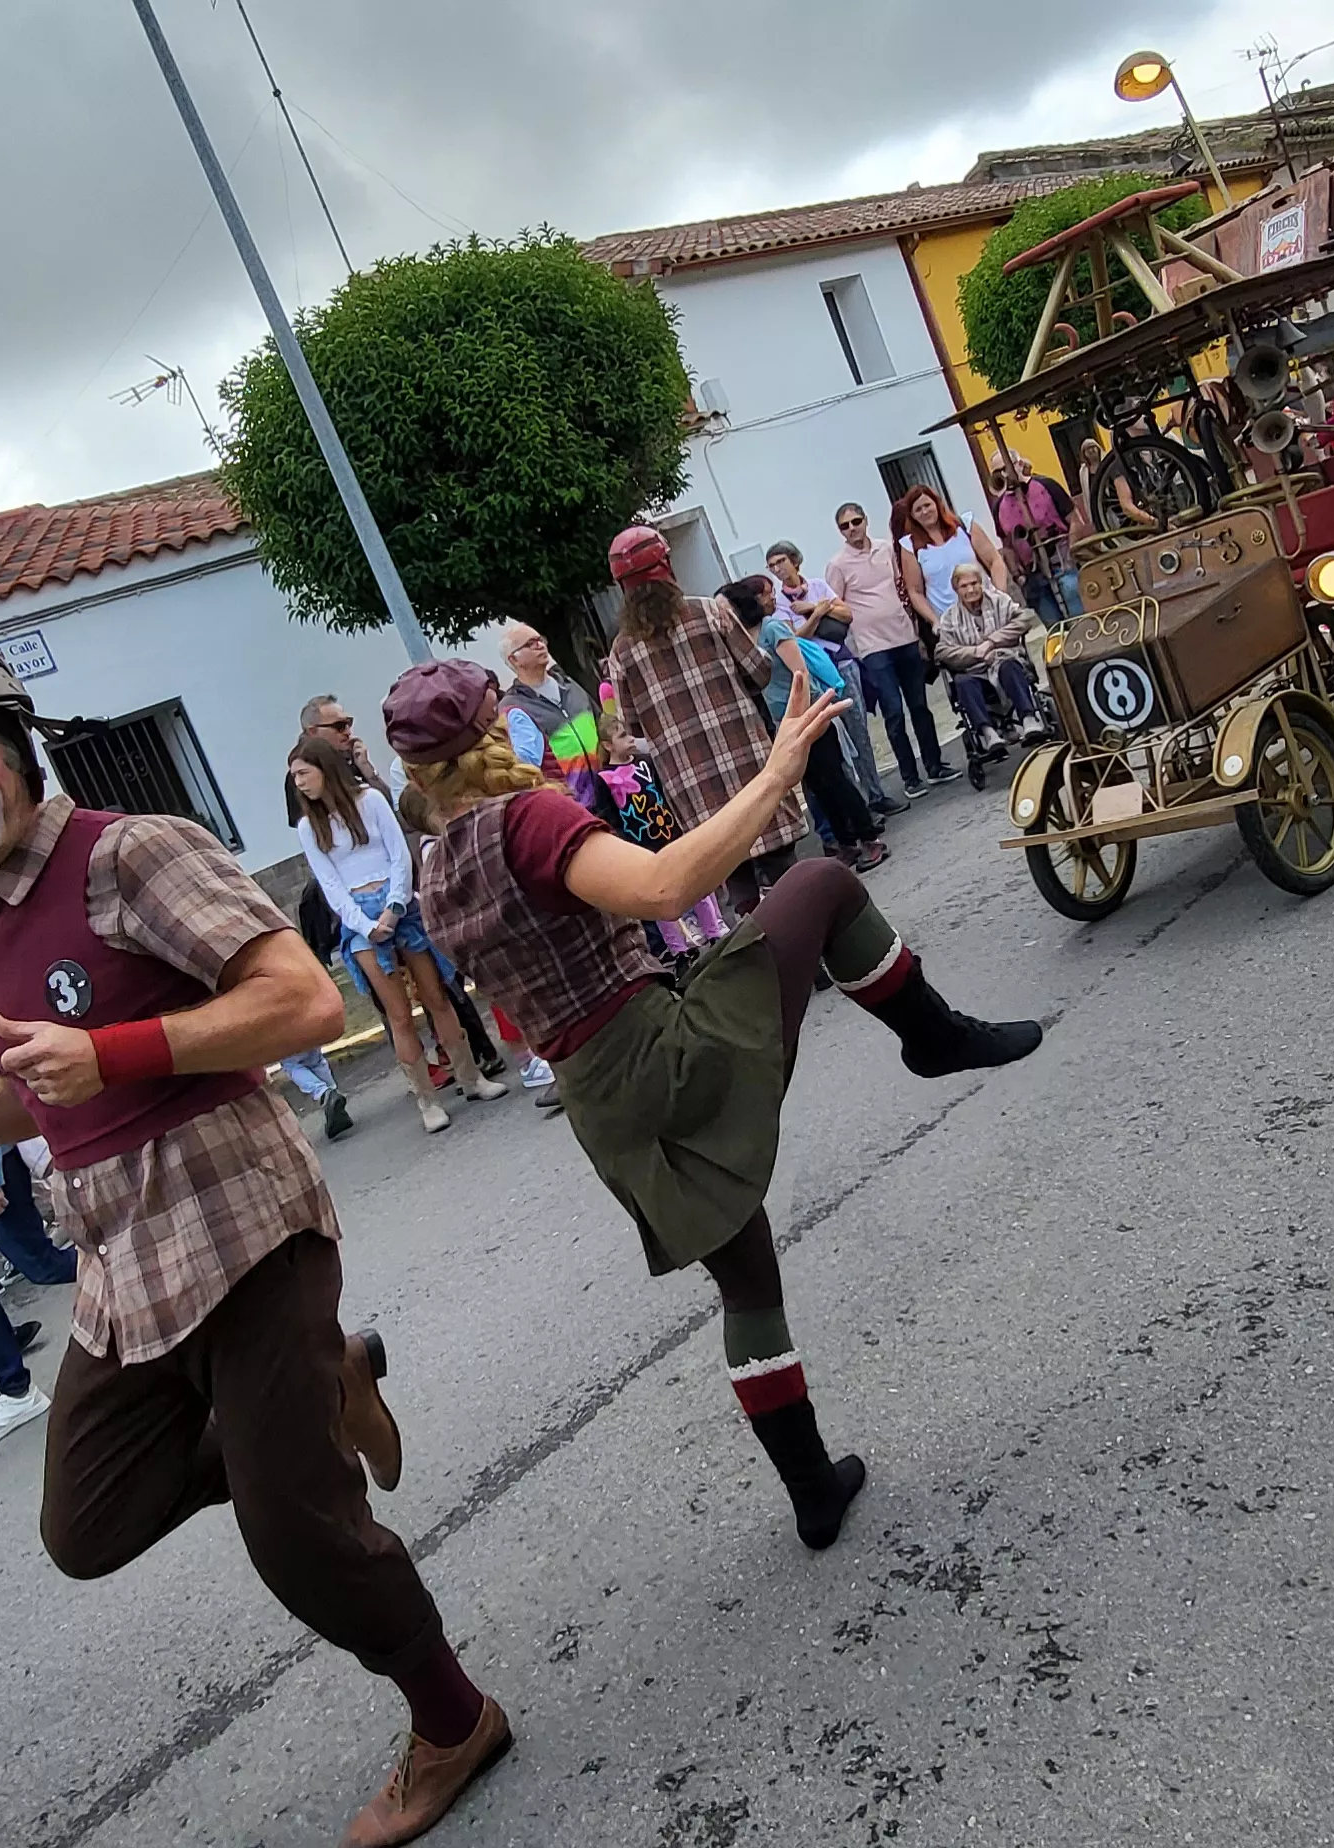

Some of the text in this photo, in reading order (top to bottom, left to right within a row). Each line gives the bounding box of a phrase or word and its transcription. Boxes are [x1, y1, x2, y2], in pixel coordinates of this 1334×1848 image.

[1267, 211, 1299, 240] CIRCUS
[9, 640, 38, 656] Calle
[1103, 669, 1137, 716] 8
[48, 969, 78, 1013] 3
